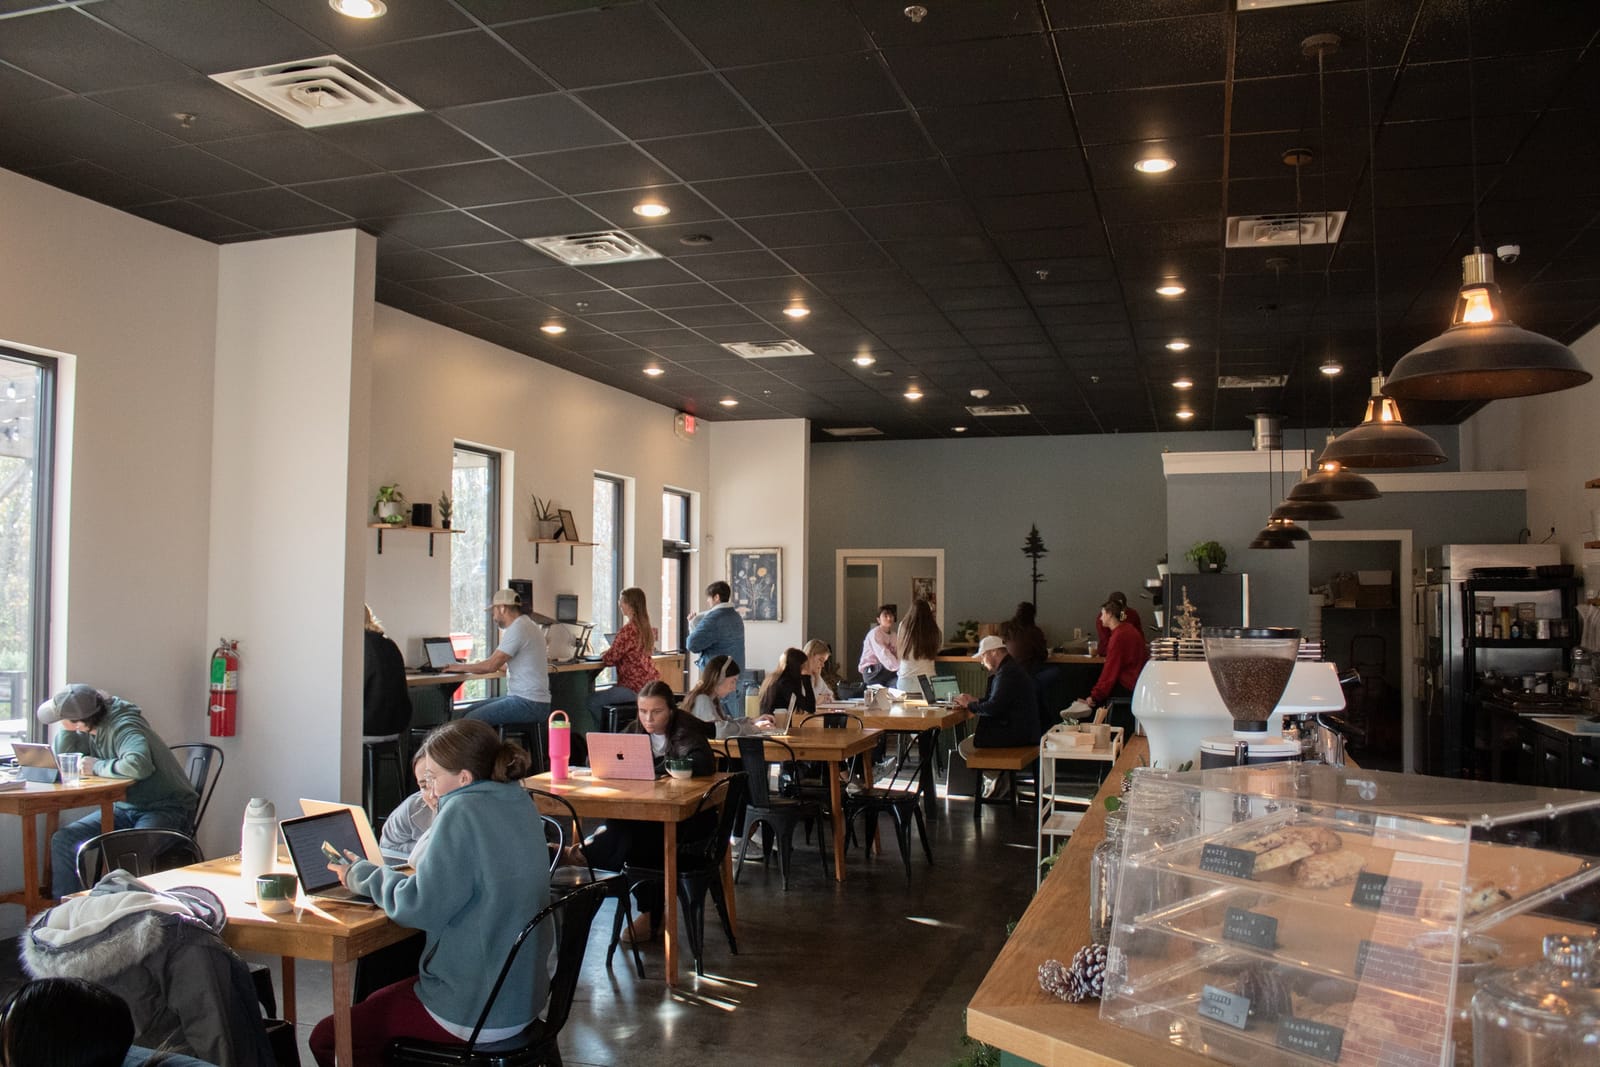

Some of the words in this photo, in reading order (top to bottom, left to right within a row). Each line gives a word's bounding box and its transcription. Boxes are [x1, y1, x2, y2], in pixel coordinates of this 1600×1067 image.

[1207, 849, 1228, 858] WHITE
[1205, 857, 1242, 869] CHOCOLATE
[1288, 1035, 1318, 1049] ORANGE
